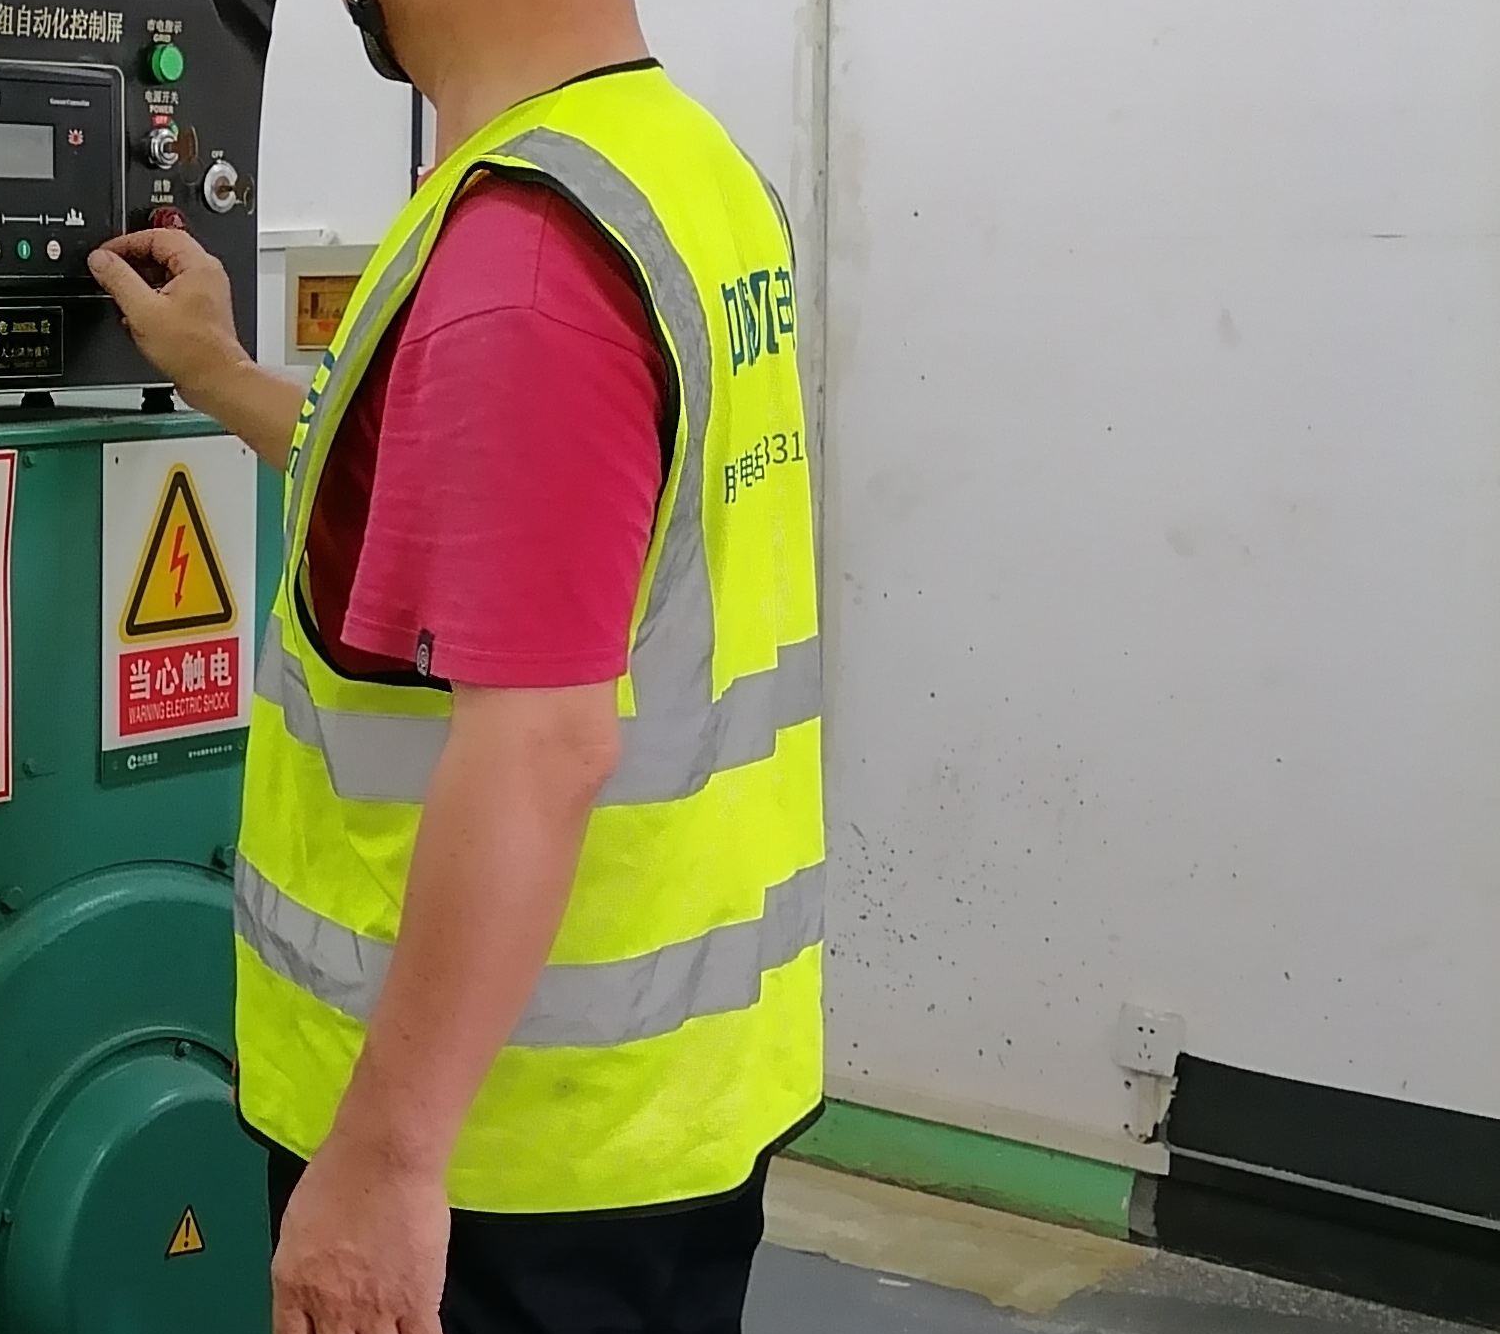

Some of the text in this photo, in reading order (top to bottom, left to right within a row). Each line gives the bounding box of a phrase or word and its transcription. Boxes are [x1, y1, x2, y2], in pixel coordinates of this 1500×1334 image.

[144, 89, 179, 105] 电源开关
[149, 104, 174, 115] POWER
[150, 194, 174, 204] ALARM
[128, 647, 232, 701] 当心触电
[128, 692, 231, 725] WARNING ELECTRIC SHOCK
